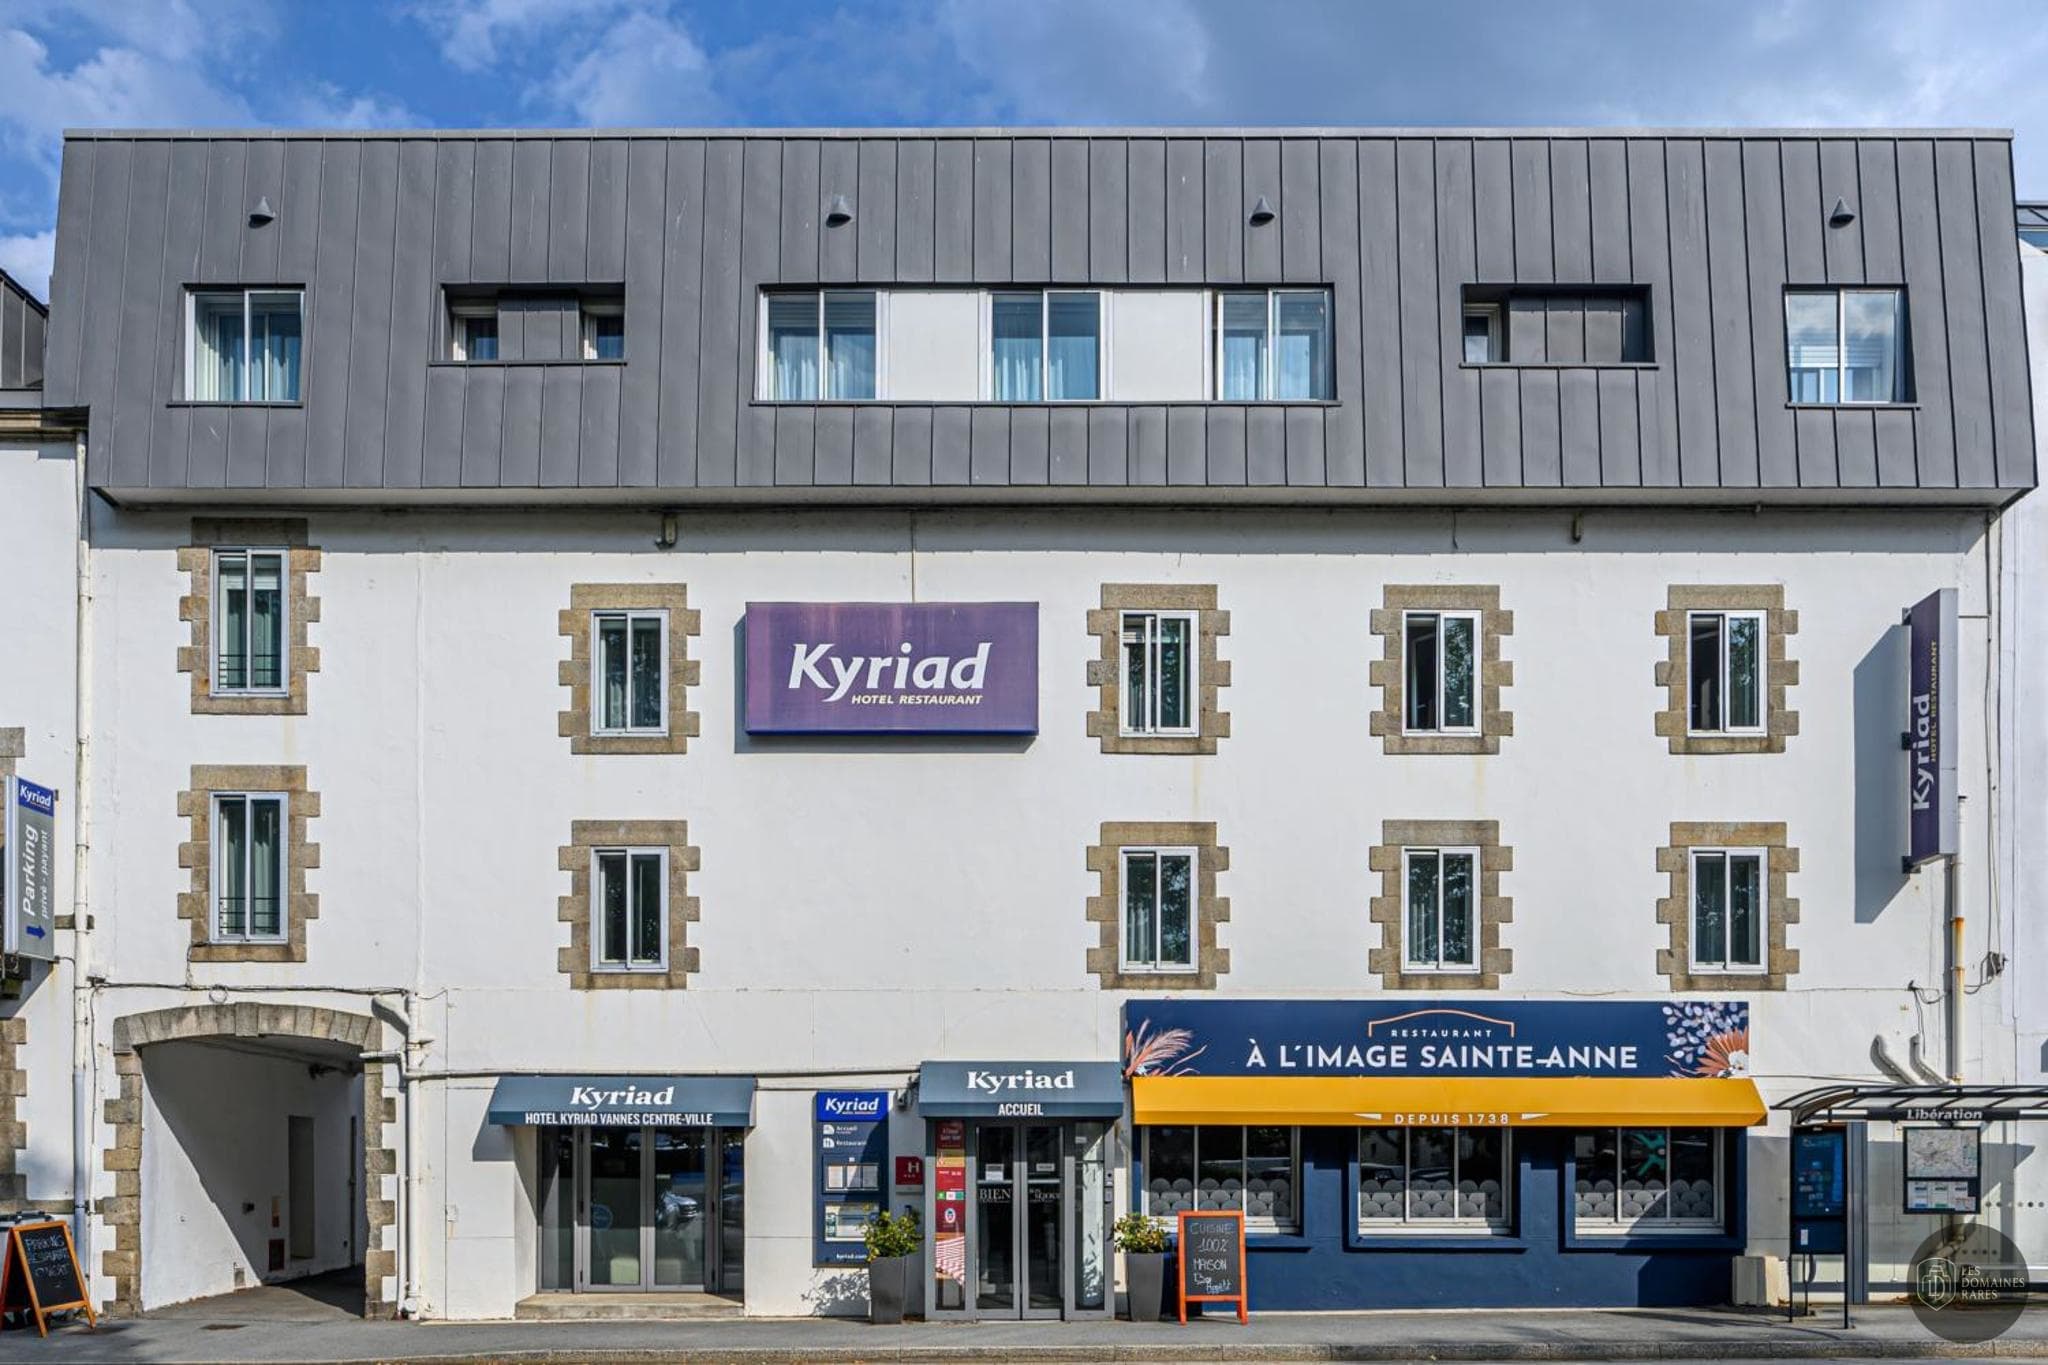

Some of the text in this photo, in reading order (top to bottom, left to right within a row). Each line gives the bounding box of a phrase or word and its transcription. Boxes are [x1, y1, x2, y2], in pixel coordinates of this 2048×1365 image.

[788, 642, 993, 702] Kyriad
[851, 694, 983, 705] HOTEL RESTAURANT
[1913, 694, 1934, 811] Kyriad
[20, 783, 52, 807] Kyriad
[23, 824, 39, 917] Parking
[1391, 1029, 1492, 1038] RESTAURANT
[1246, 1038, 1638, 1069] À L'IMAGE SAINTE-ANNE
[967, 1069, 1075, 1094] Kyriad
[570, 1085, 675, 1110] Kyriad
[825, 1097, 880, 1114] Kyriad
[998, 1103, 1044, 1116] ACCUEIL
[525, 1112, 713, 1125] HOTEL KYRIAD VANNES CENTRE-VILLE
[1394, 1113, 1510, 1125] DEPUIS 1738
[1907, 1109, 1983, 1120] Libération
[908, 1161, 920, 1173] H
[1191, 1222, 1234, 1235] CUISINE
[1199, 1238, 1229, 1253] 100%
[1193, 1258, 1227, 1271] MAISON
